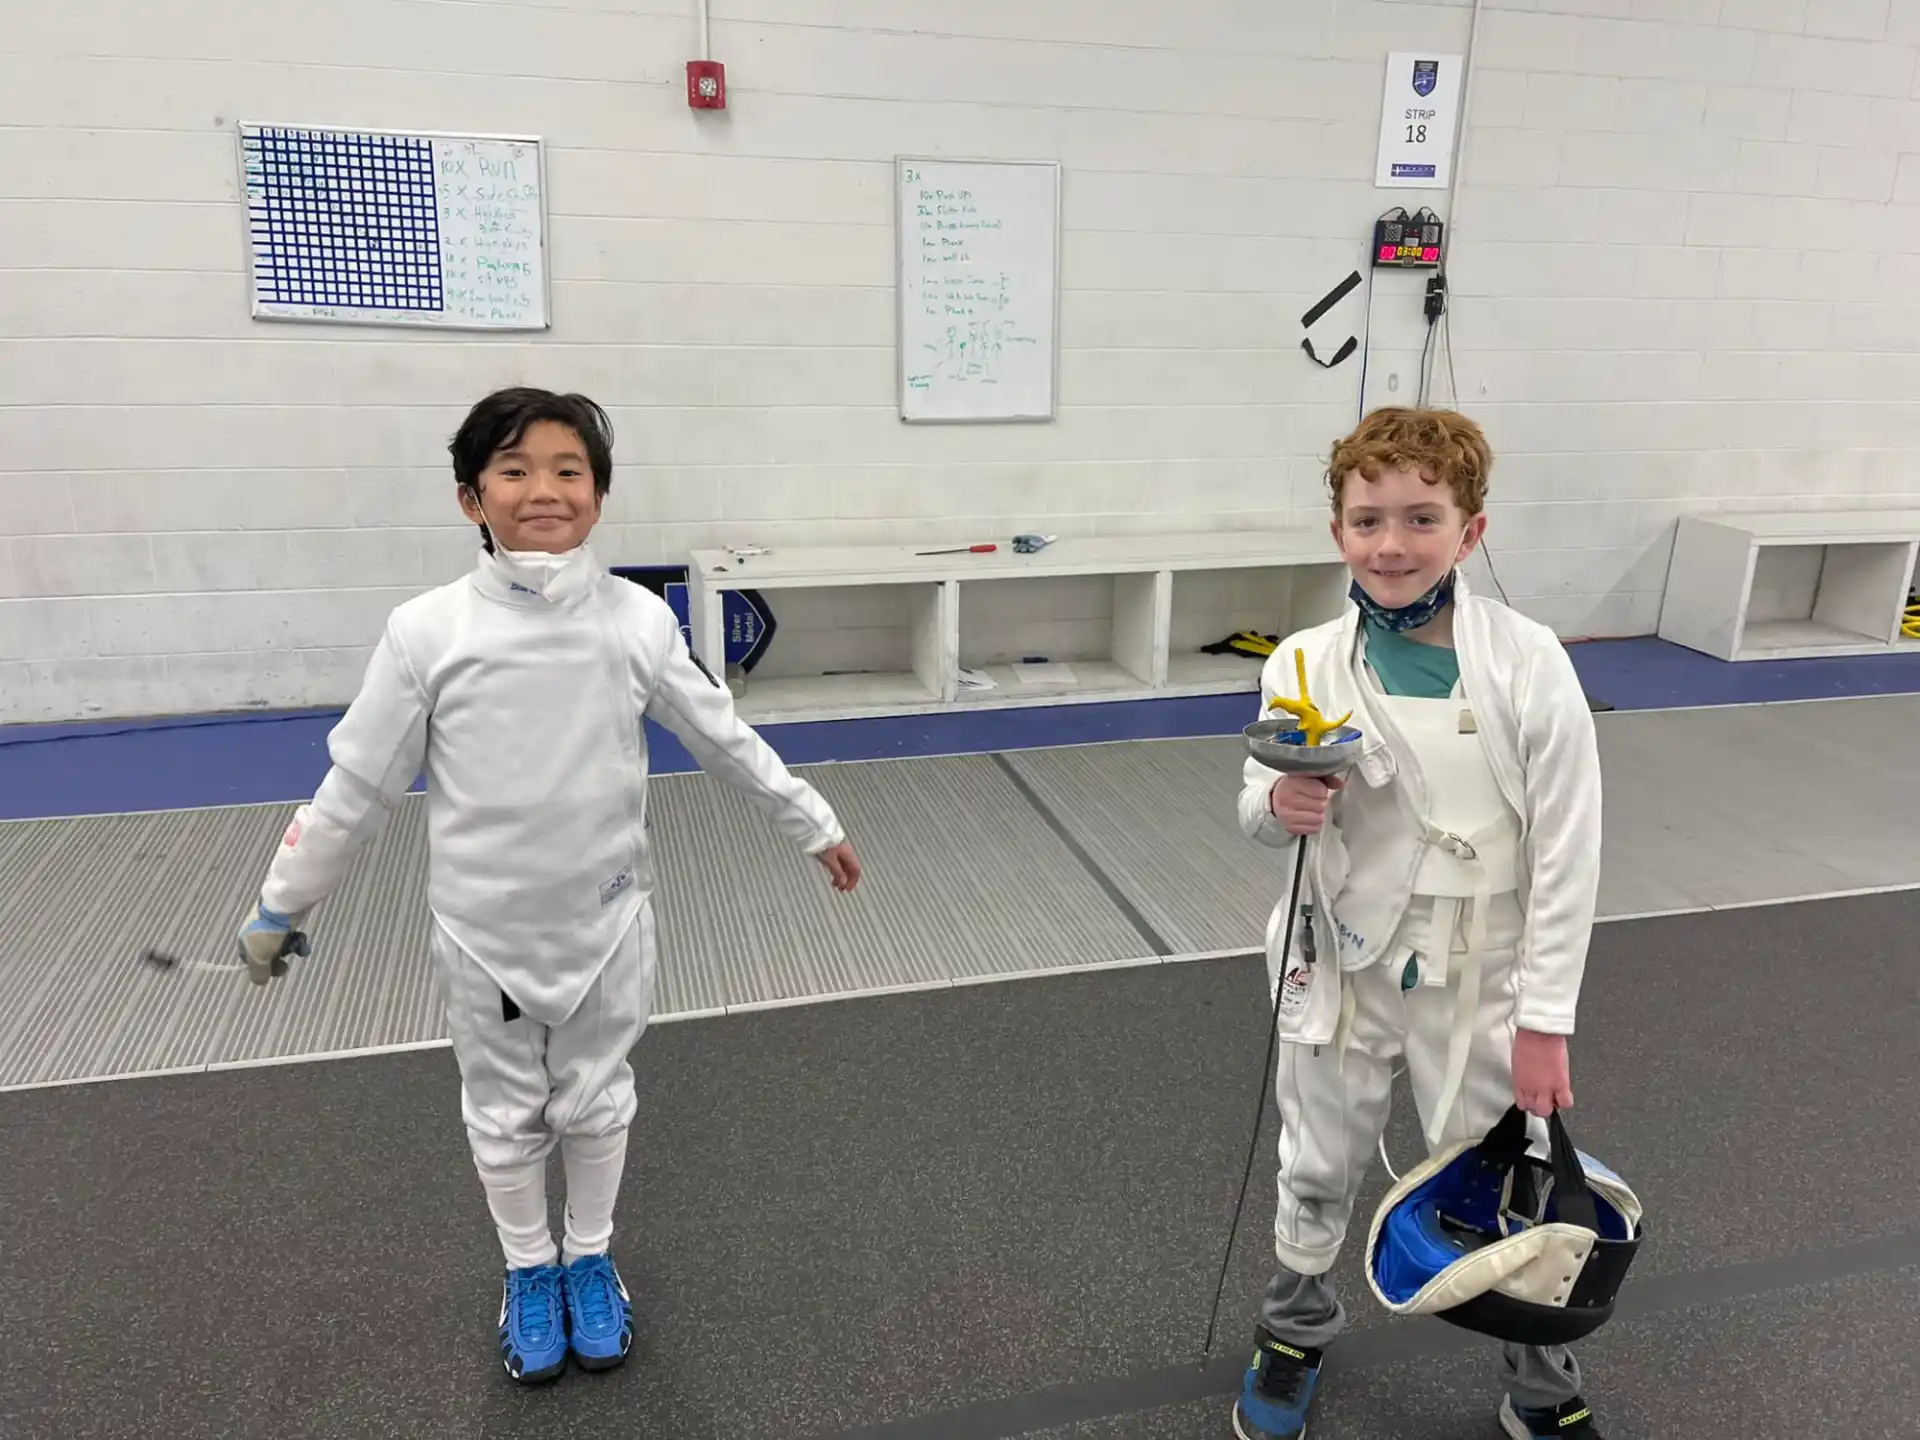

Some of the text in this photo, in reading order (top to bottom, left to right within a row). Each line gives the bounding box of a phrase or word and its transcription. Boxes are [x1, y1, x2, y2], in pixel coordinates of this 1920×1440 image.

[1405, 108, 1436, 120] STRIP
[1405, 124, 1427, 143] 18
[479, 156, 517, 181] Run
[732, 613, 741, 643] Silver
